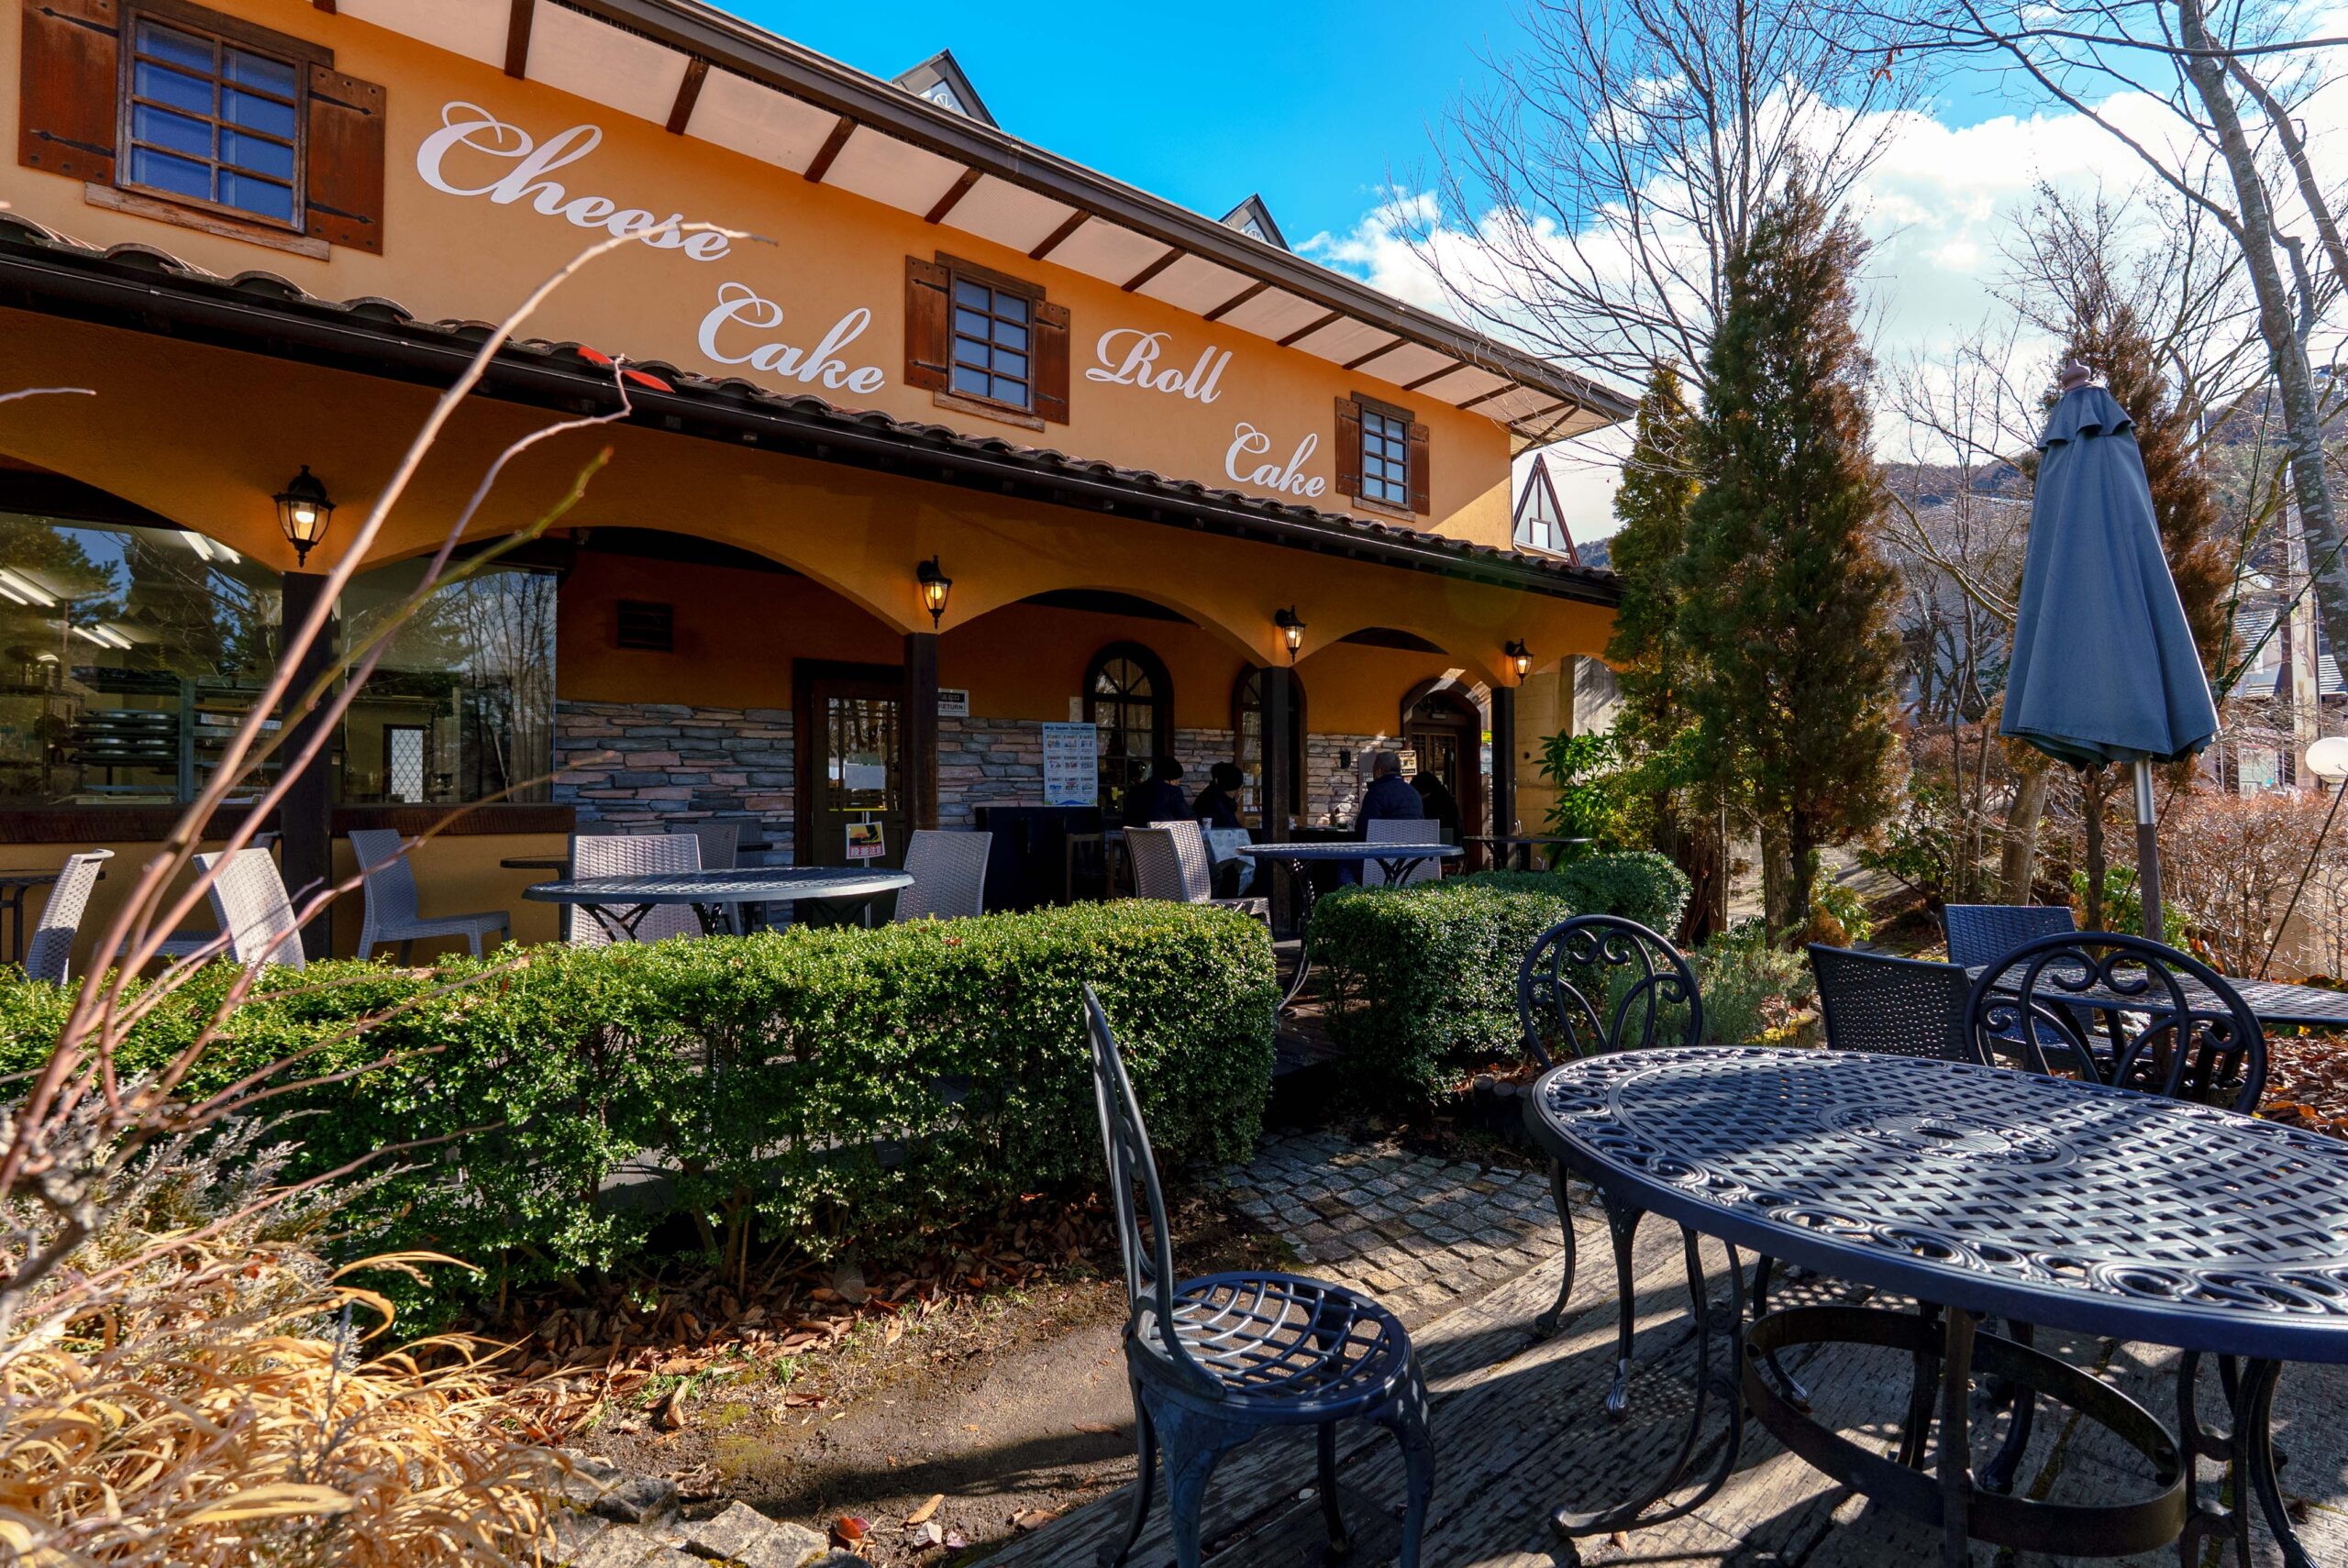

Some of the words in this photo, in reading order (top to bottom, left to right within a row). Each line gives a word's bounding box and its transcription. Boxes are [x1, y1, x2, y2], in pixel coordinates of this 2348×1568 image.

[416, 101, 731, 261] Cheese
[697, 282, 885, 394] Cake
[1085, 328, 1233, 403] Roll
[1224, 422, 1326, 498] Cake
